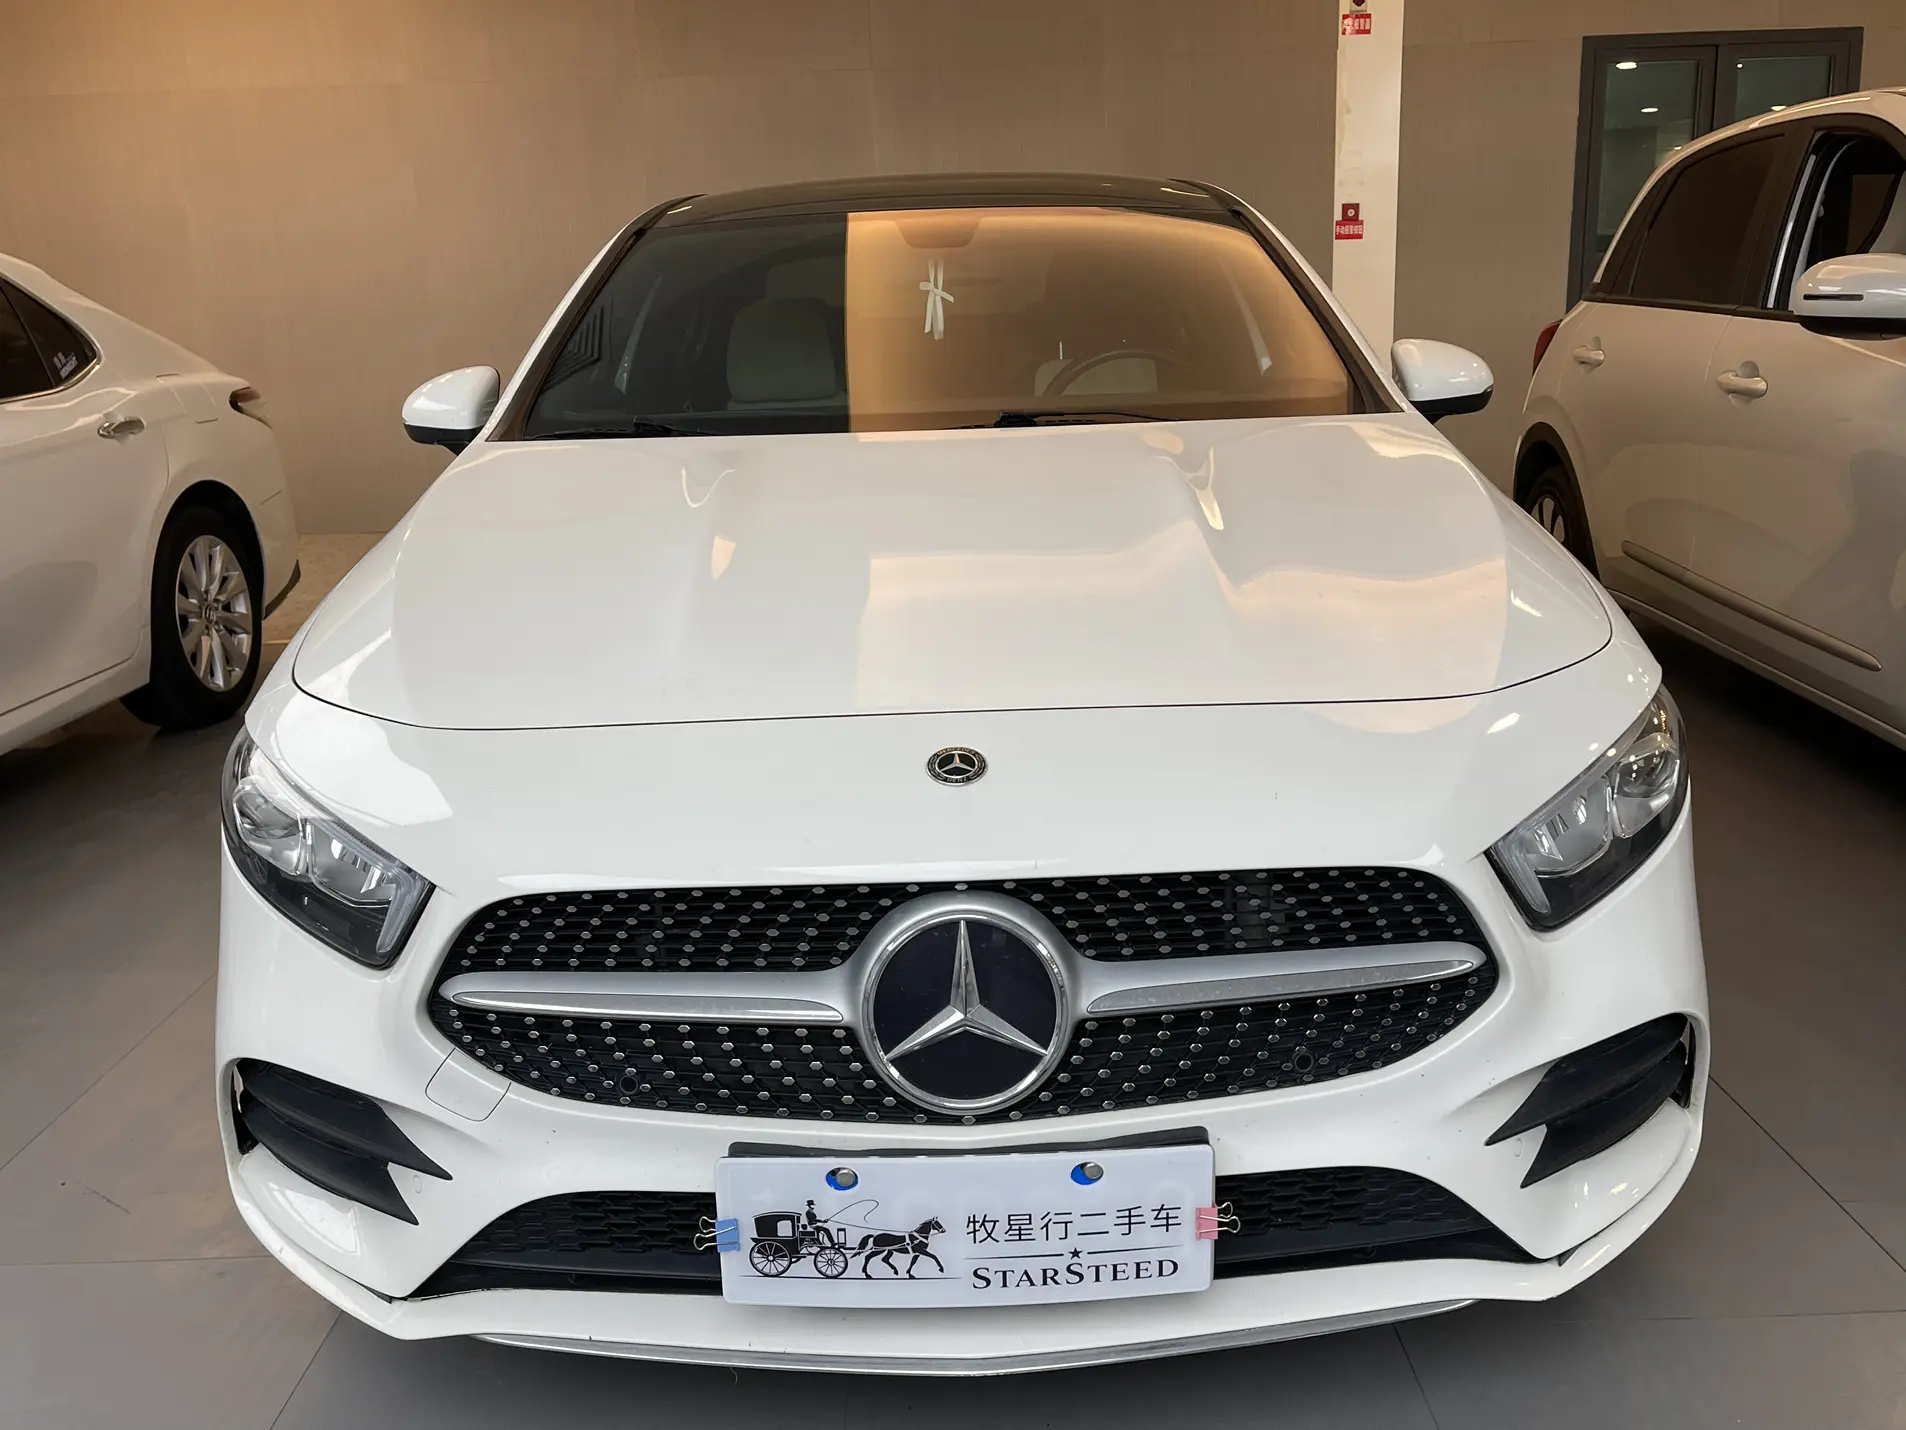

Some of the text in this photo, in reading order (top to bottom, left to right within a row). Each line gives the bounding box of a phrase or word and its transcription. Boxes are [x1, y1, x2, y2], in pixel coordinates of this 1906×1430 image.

[966, 1203, 1182, 1244] 牧星行二手车
[972, 1259, 1179, 1290] STARSTEED
